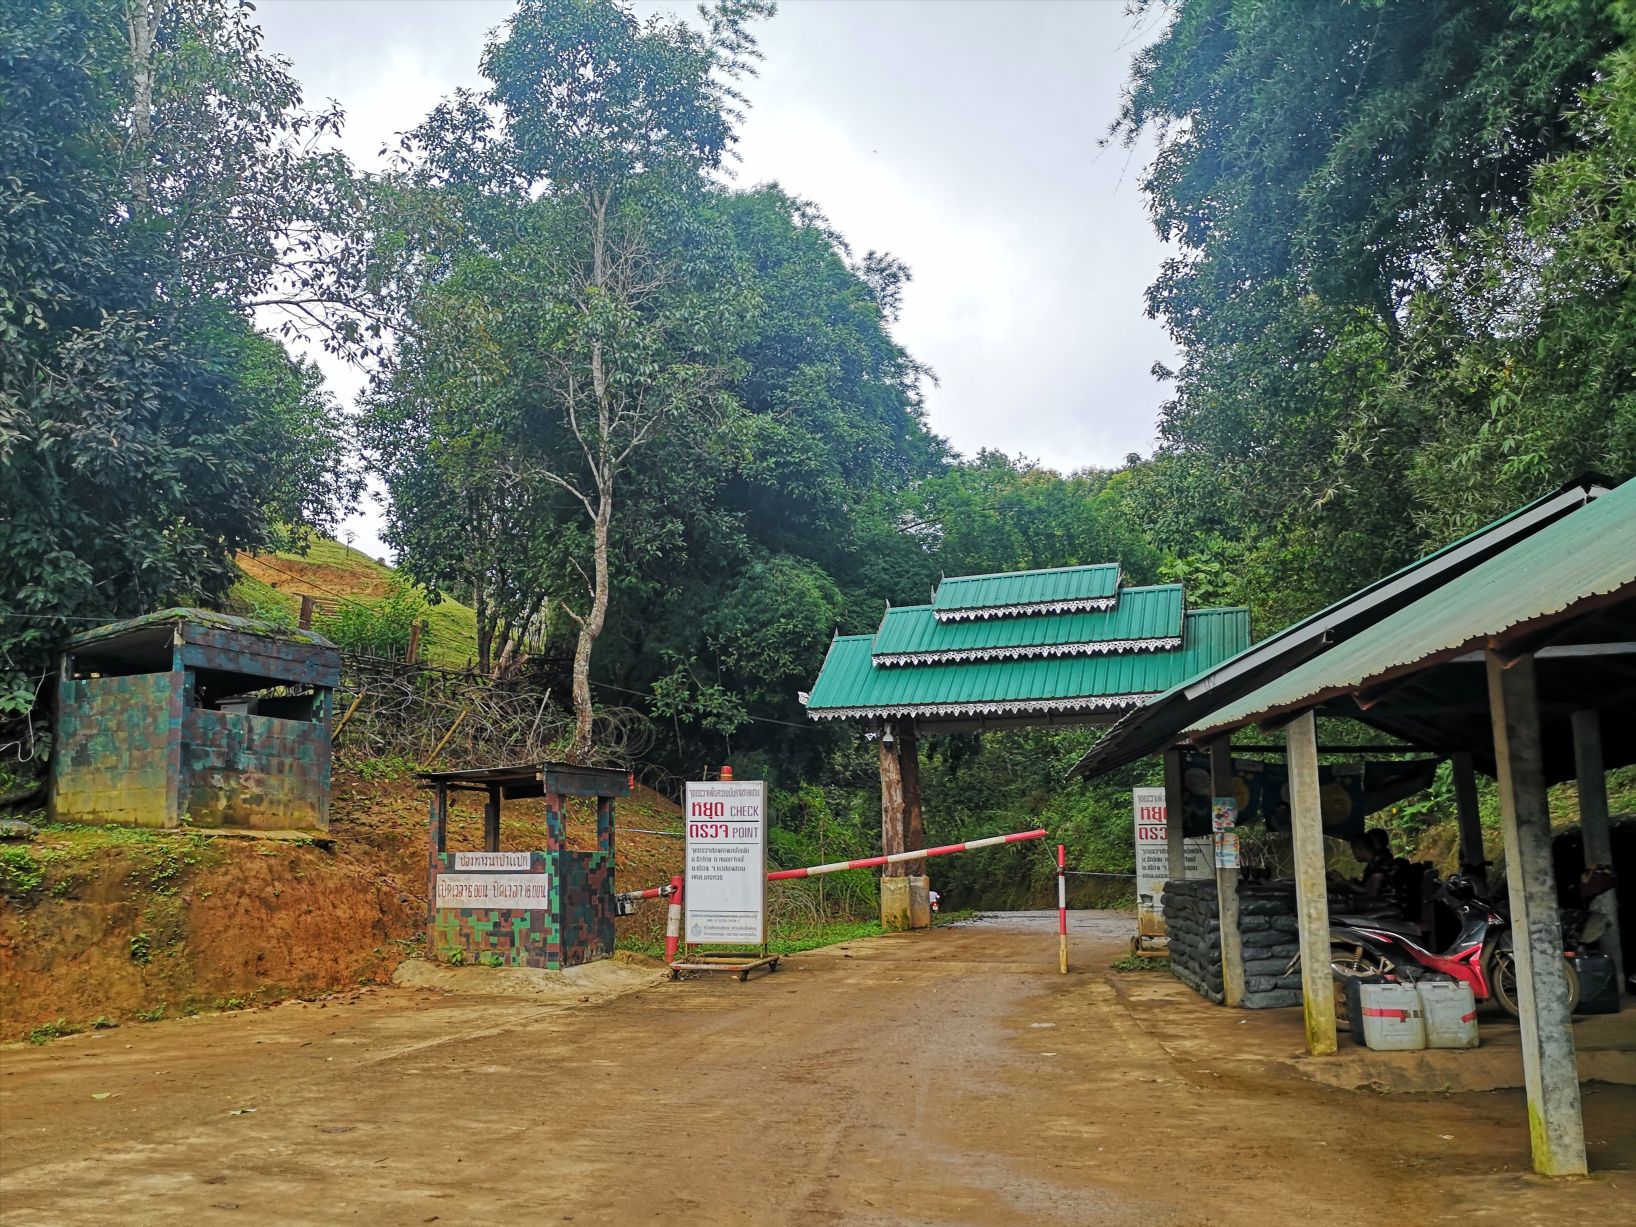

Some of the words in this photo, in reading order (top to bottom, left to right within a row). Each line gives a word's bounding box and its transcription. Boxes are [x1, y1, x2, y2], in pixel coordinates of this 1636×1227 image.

[692, 801, 724, 819] หยุด
[730, 805, 759, 817] CHECK
[689, 824, 729, 838] ตรวจ
[732, 827, 759, 838] POINT
[1138, 827, 1168, 840] ตรว
